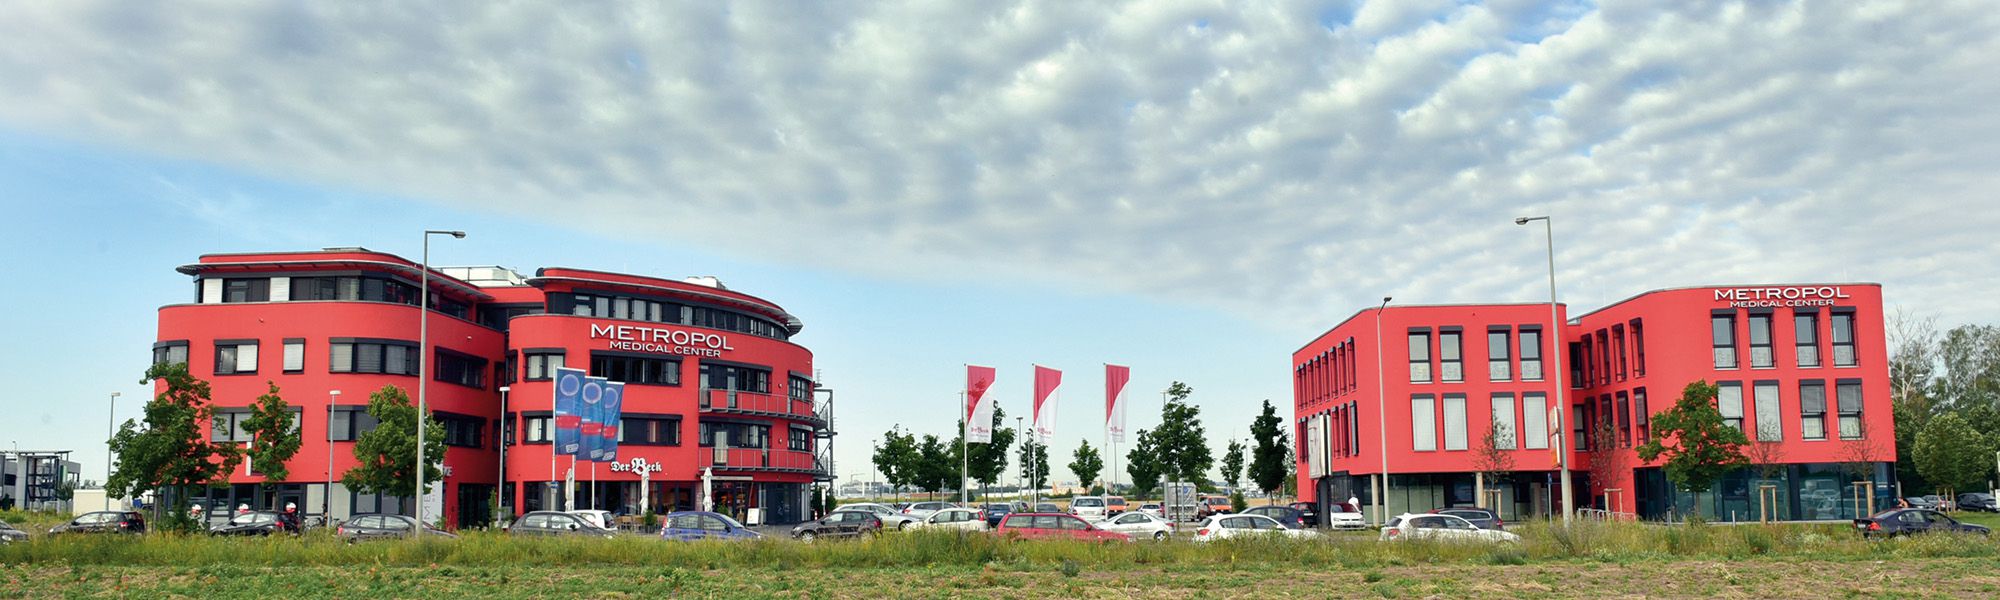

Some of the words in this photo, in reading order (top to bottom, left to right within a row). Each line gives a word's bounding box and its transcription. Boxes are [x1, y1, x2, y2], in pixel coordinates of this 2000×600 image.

[1714, 286, 1850, 300] METROPOL
[1730, 299, 1783, 308] MEDICAL
[1785, 299, 1835, 307] CENTER
[590, 323, 734, 350] METROPOL
[609, 341, 671, 353] MEDICAL
[674, 345, 721, 357] CENTER
[610, 461, 630, 471] Der
